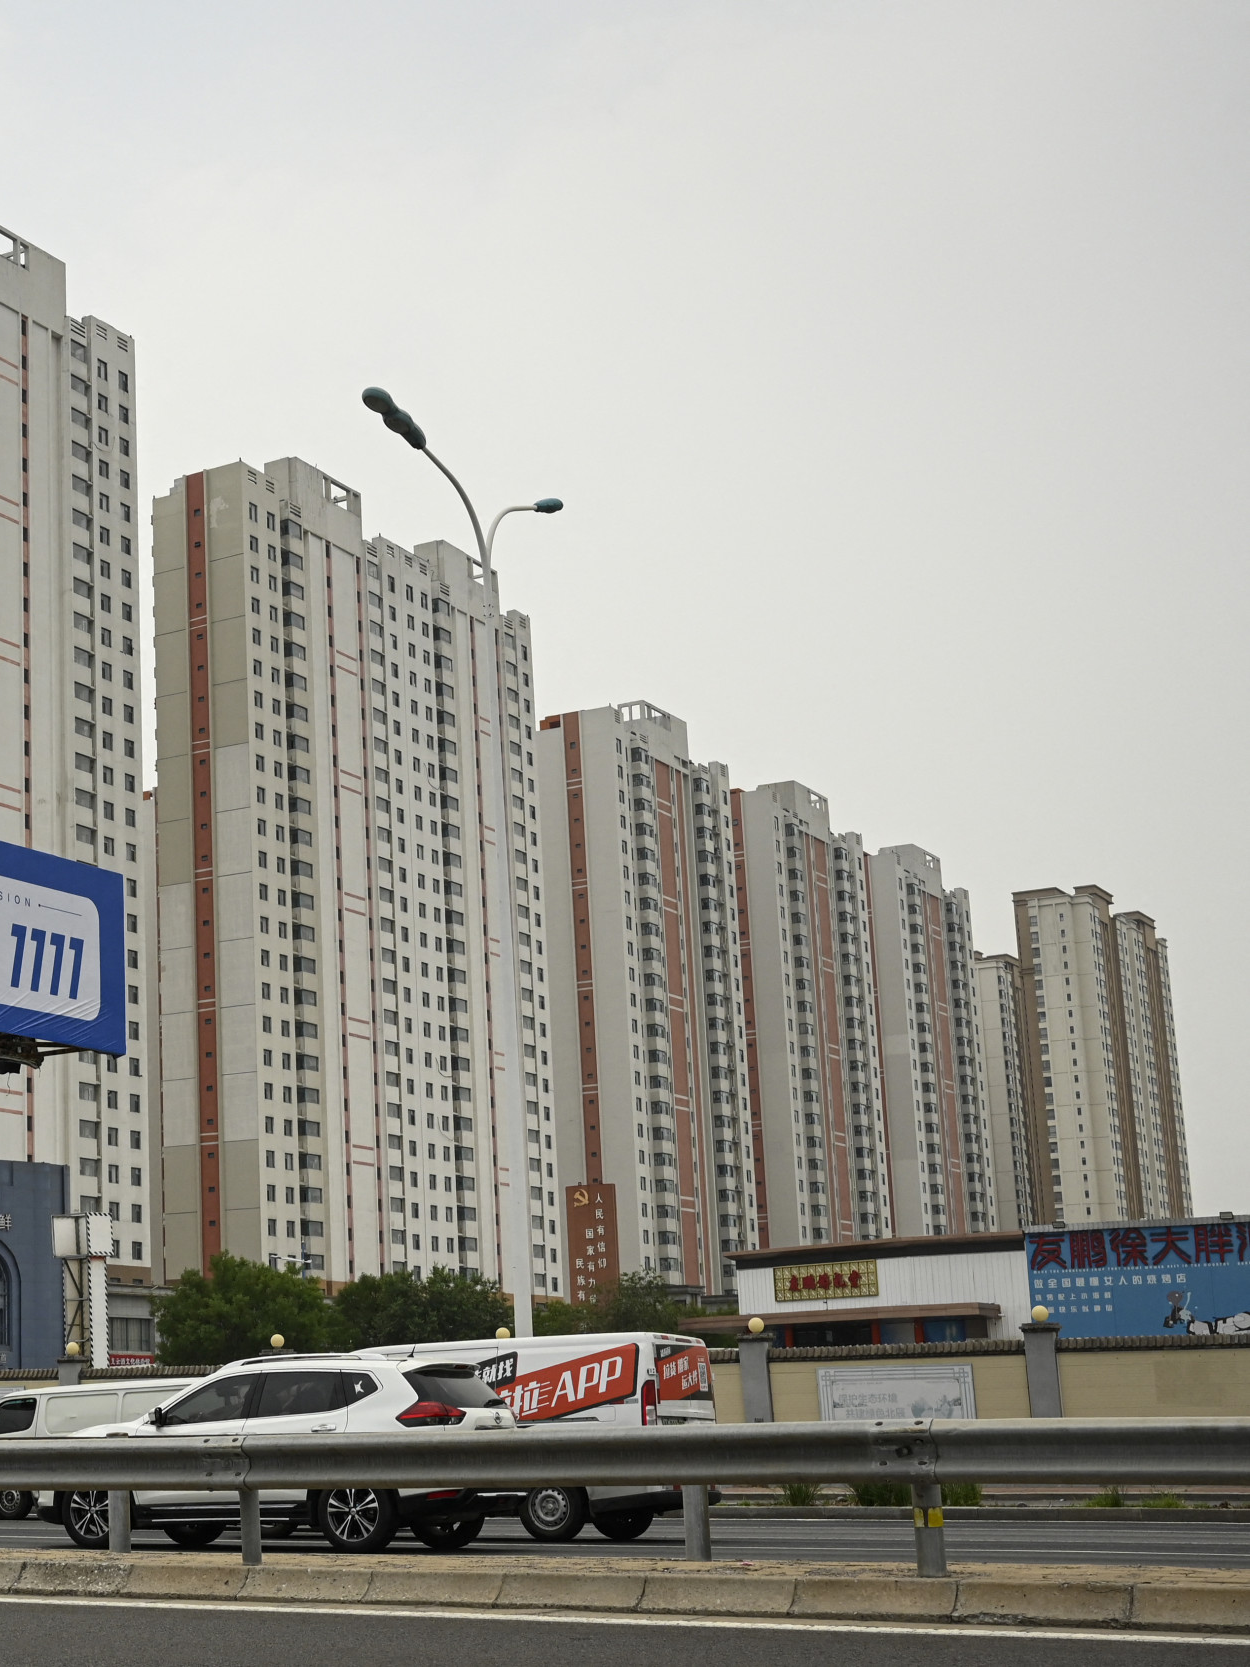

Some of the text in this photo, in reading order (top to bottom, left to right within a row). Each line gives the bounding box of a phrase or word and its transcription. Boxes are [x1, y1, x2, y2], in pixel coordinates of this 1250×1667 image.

[10, 923, 84, 1000] 1111
[595, 1192, 607, 1269] 人民有信仰
[552, 1356, 623, 1407] APP
[663, 1361, 677, 1380] 拉货
